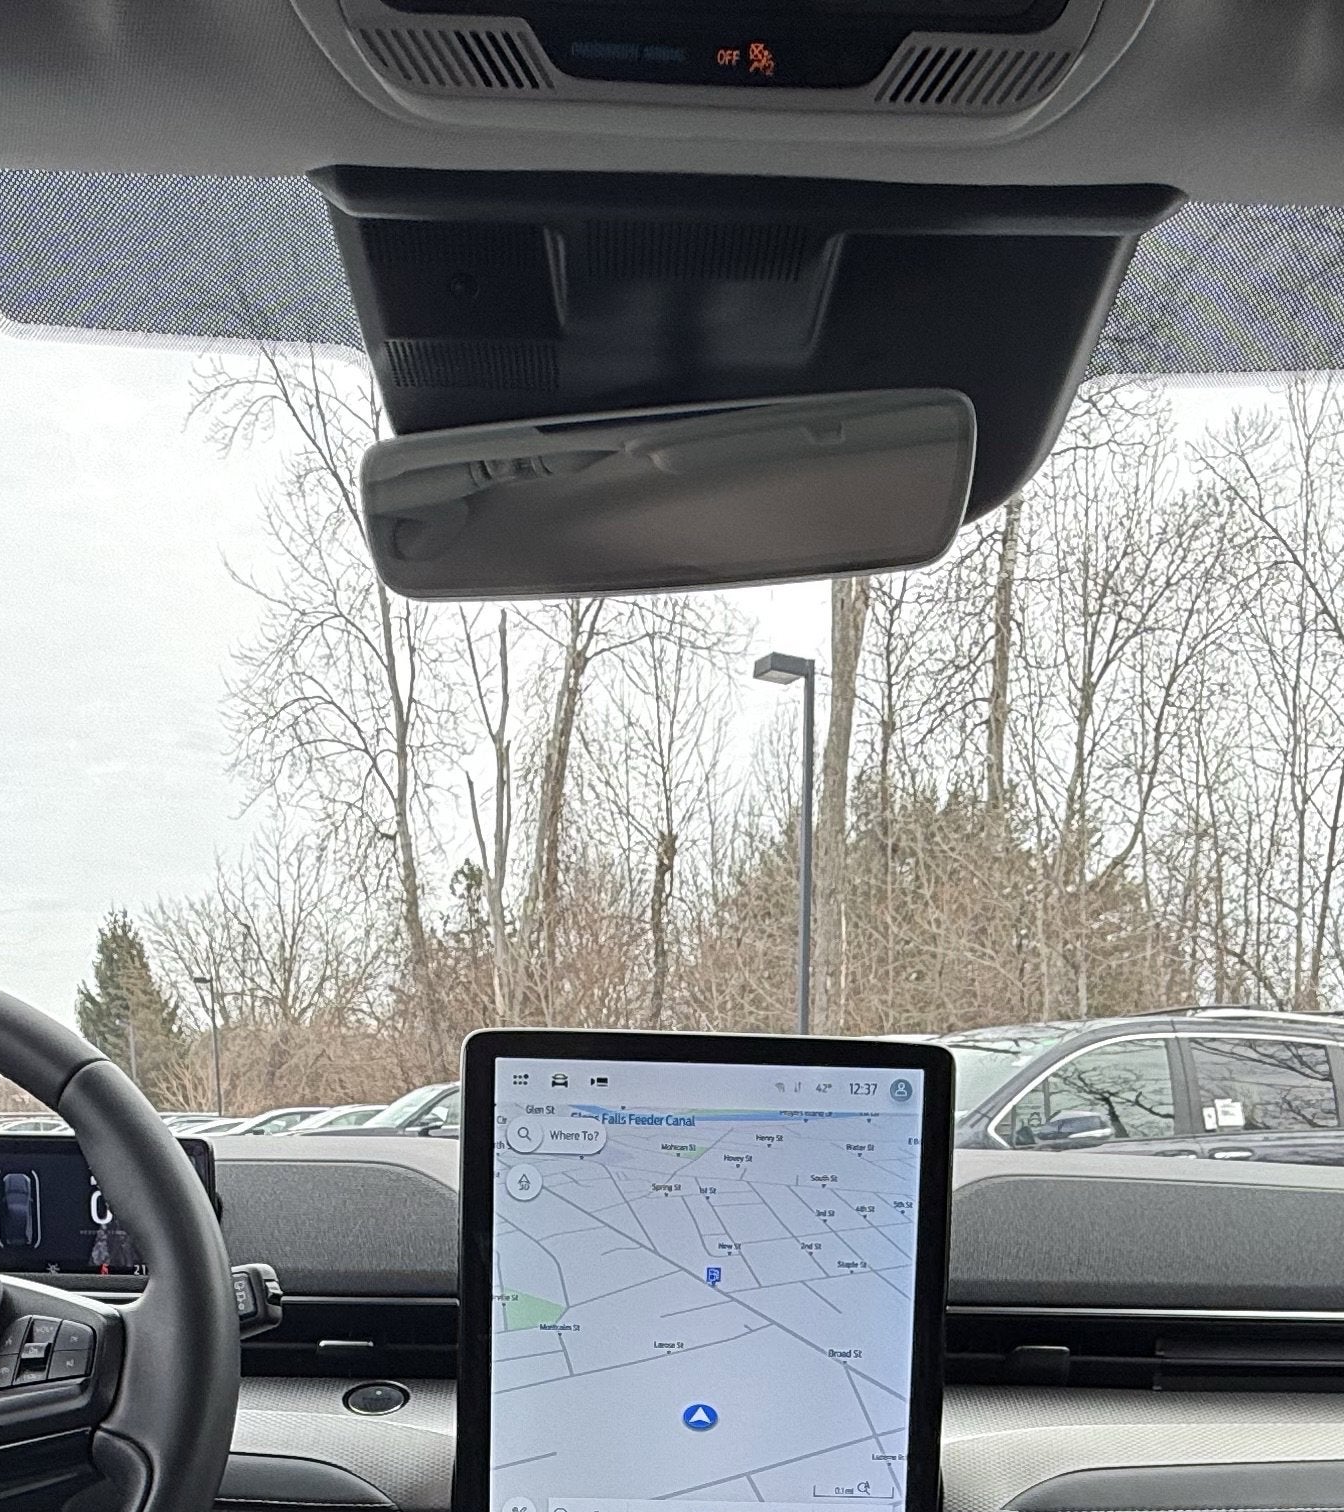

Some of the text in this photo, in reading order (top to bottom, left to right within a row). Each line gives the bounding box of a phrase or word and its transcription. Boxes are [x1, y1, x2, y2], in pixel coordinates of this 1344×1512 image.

[716, 49, 741, 66] OFF
[816, 1083, 832, 1093] 42°
[849, 1083, 878, 1096] 12:37
[526, 1105, 555, 1115] Glen St
[601, 1112, 626, 1125] Falls
[628, 1114, 664, 1126] Feeder
[666, 1115, 696, 1127] Canal
[550, 1130, 599, 1141] Where To?
[652, 1184, 673, 1194] Spring
